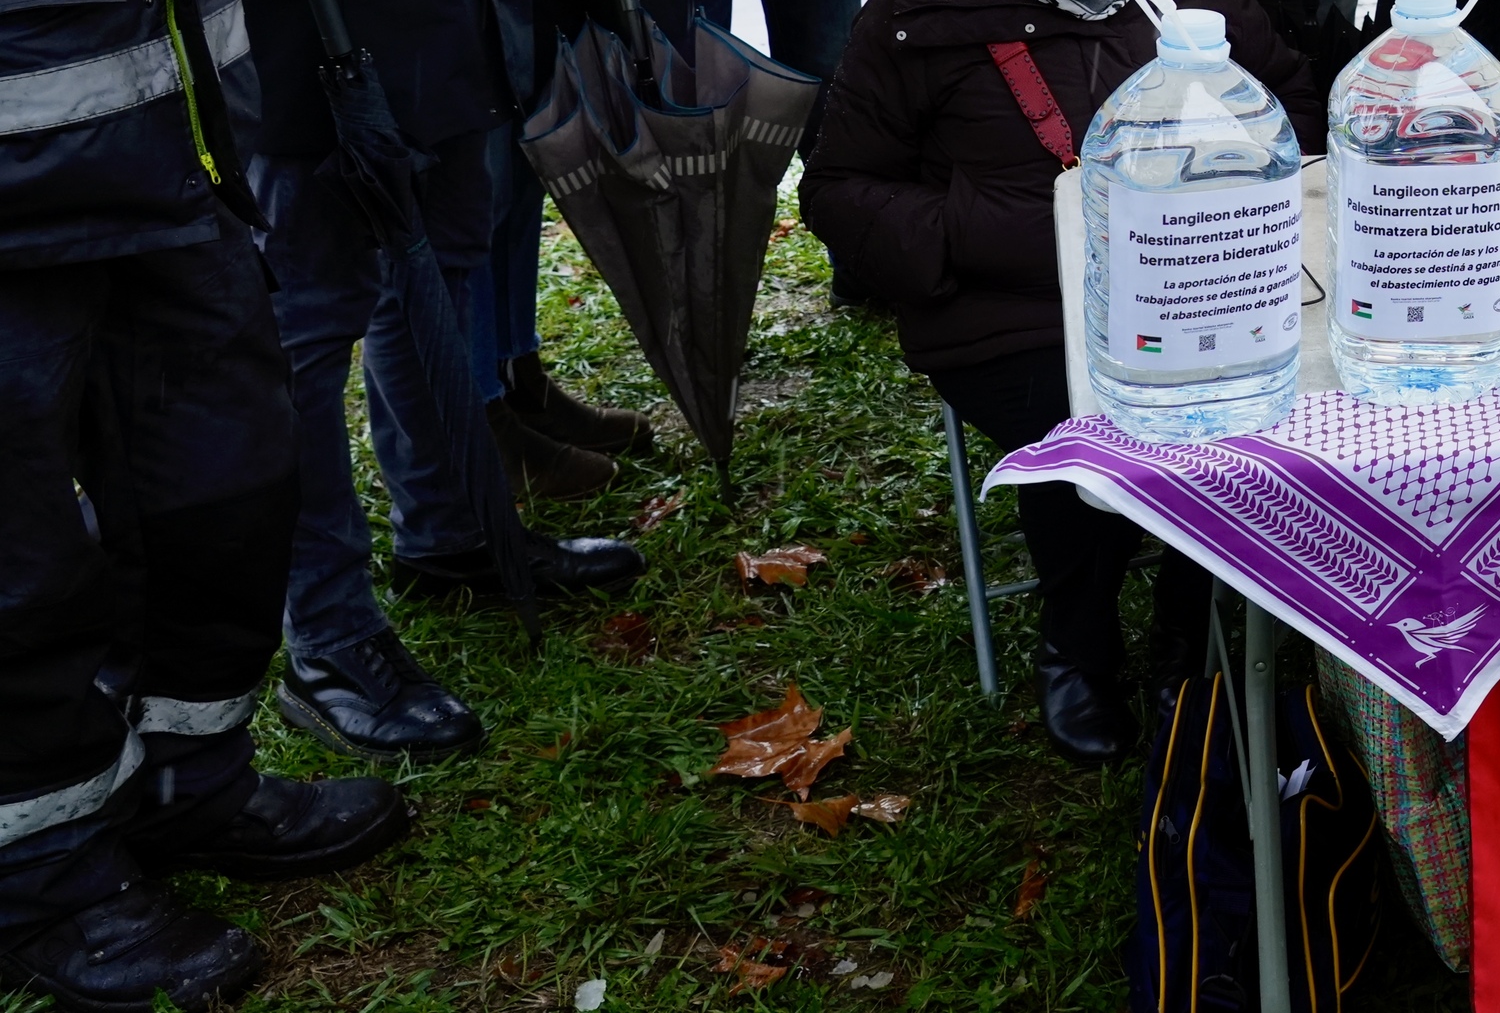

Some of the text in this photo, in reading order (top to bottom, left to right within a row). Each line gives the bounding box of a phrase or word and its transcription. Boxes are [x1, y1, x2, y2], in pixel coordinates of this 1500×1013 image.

[1373, 185, 1439, 199] Langileon
[1162, 199, 1291, 227] Langileon ekarpena
[1347, 198, 1452, 217] Palestinarrentzat
[1455, 206, 1469, 215] ur
[1129, 228, 1244, 246] Palestinarrentzat
[1247, 227, 1260, 238] ur
[1354, 221, 1428, 237] bermatzera
[1139, 232, 1300, 267] bermatzera bideratuko da
[1374, 244, 1499, 261] La aportación de las y los
[1350, 259, 1413, 275] trabajadores
[1427, 263, 1465, 273] destiná
[1163, 264, 1288, 291] La aportación de las y los
[1370, 274, 1500, 289] el abastecimiento de agua
[1135, 293, 1204, 307] trabajadores
[1206, 293, 1218, 302] se
[1220, 284, 1257, 300] destiná
[1259, 285, 1265, 293] a
[1159, 293, 1289, 321] el abastecimiento de agua
